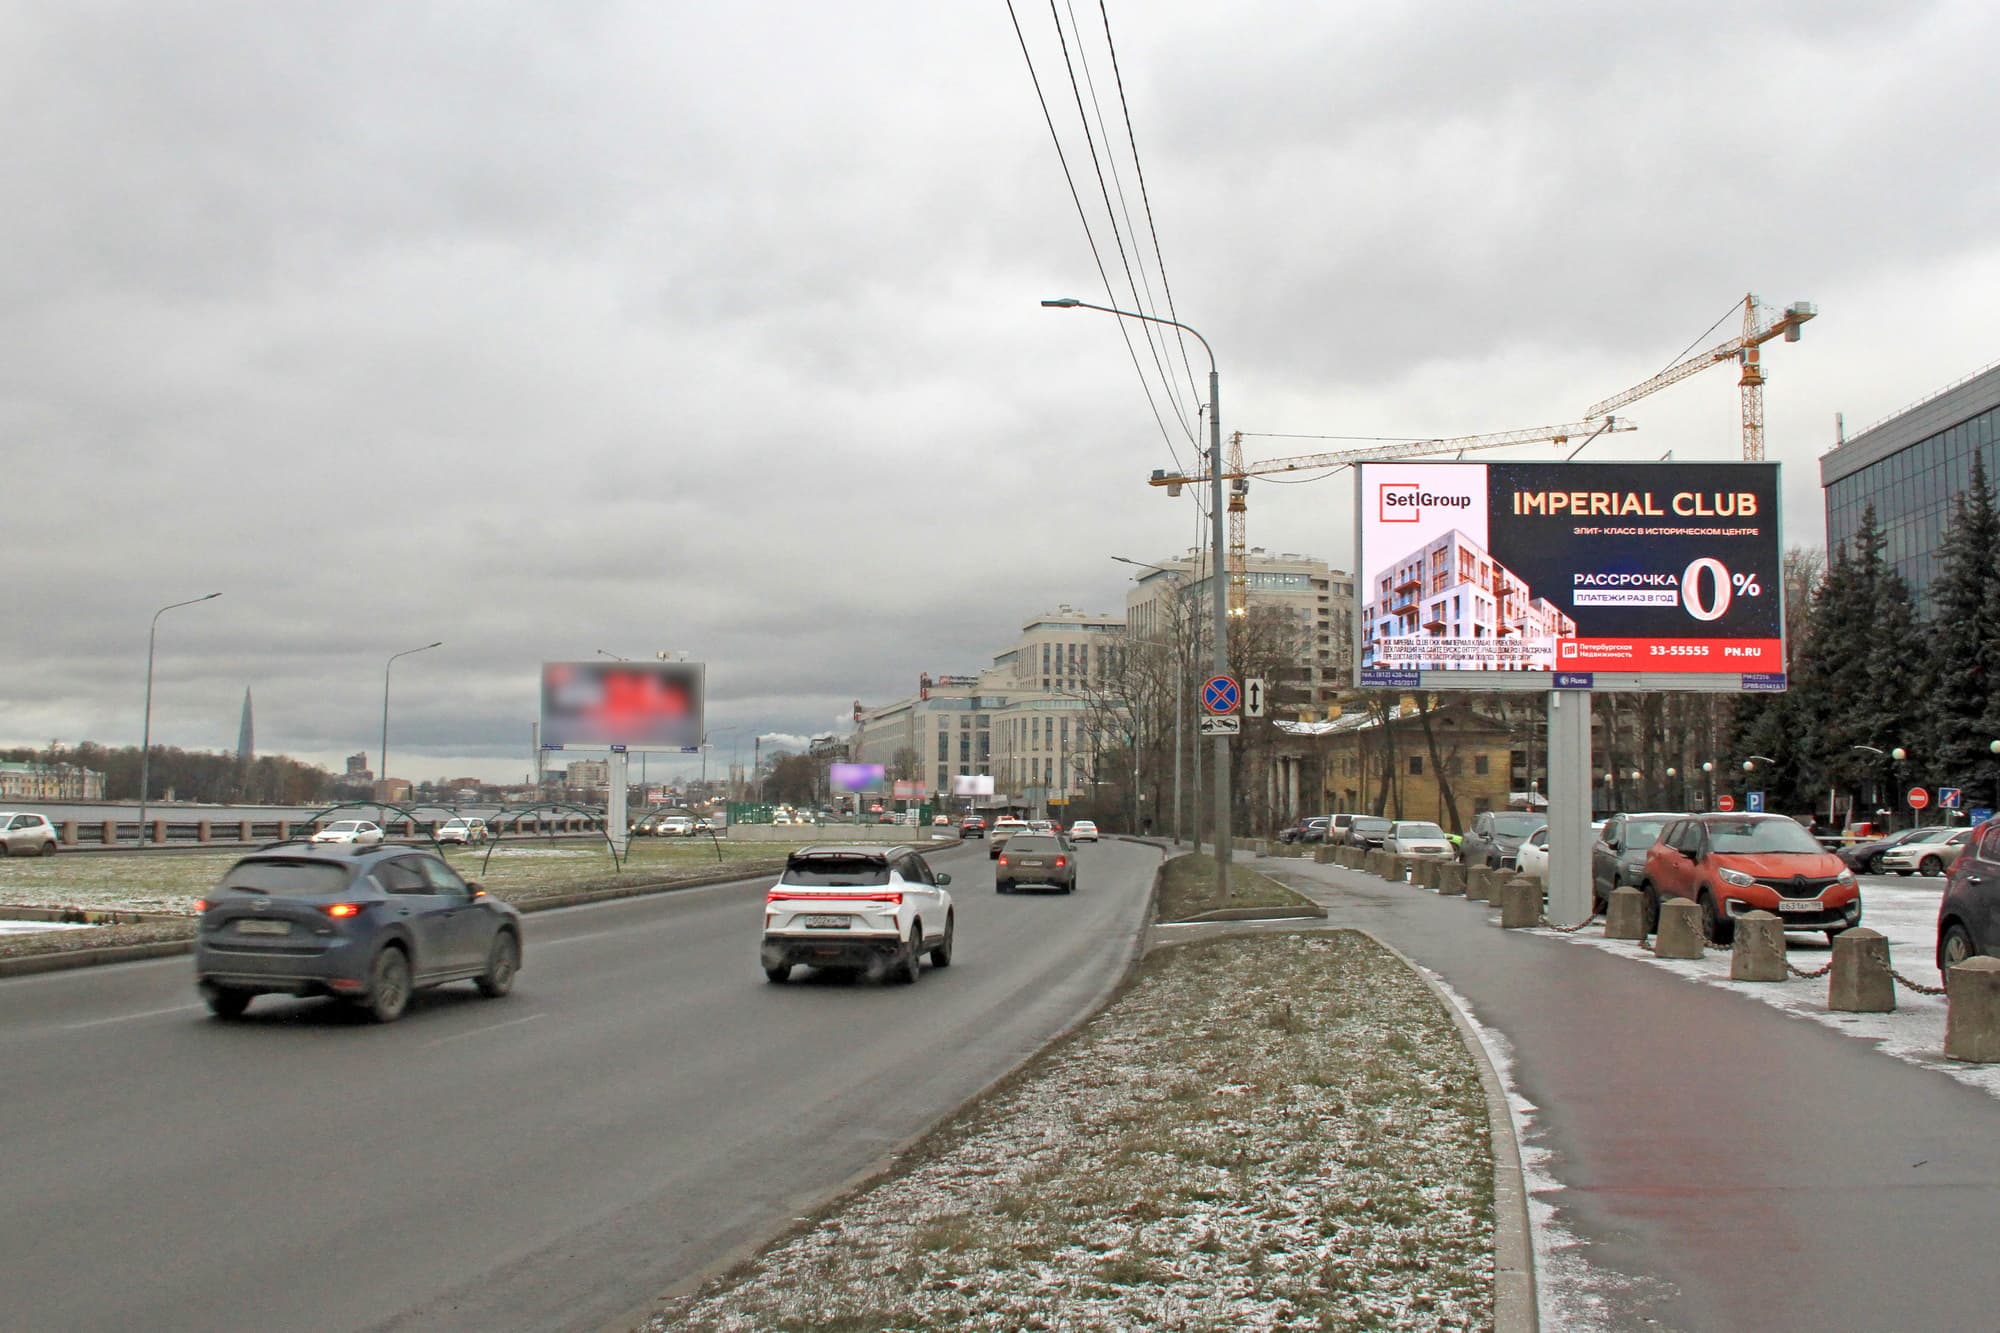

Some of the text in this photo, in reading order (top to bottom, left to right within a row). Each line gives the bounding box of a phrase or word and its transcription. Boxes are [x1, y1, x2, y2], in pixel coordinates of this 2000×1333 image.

[1513, 491, 1758, 516] IMPERIAL CLUB
[1604, 527, 1636, 535] КЛАСС
[1645, 528, 1721, 536] ИСТОРИЧЕСКОМ
[1722, 528, 1760, 536] ЦЕНТРЕ
[1573, 574, 1678, 586] РАССРОЧКА
[1576, 594, 1625, 602] ПЛАТЕЖИ
[1627, 594, 1646, 602] РАЗ
[1655, 595, 1675, 603] ГОД
[1579, 643, 1632, 651] Петербургская
[1650, 646, 1710, 656] 33-55555
[1724, 647, 1762, 656] PN.RU
